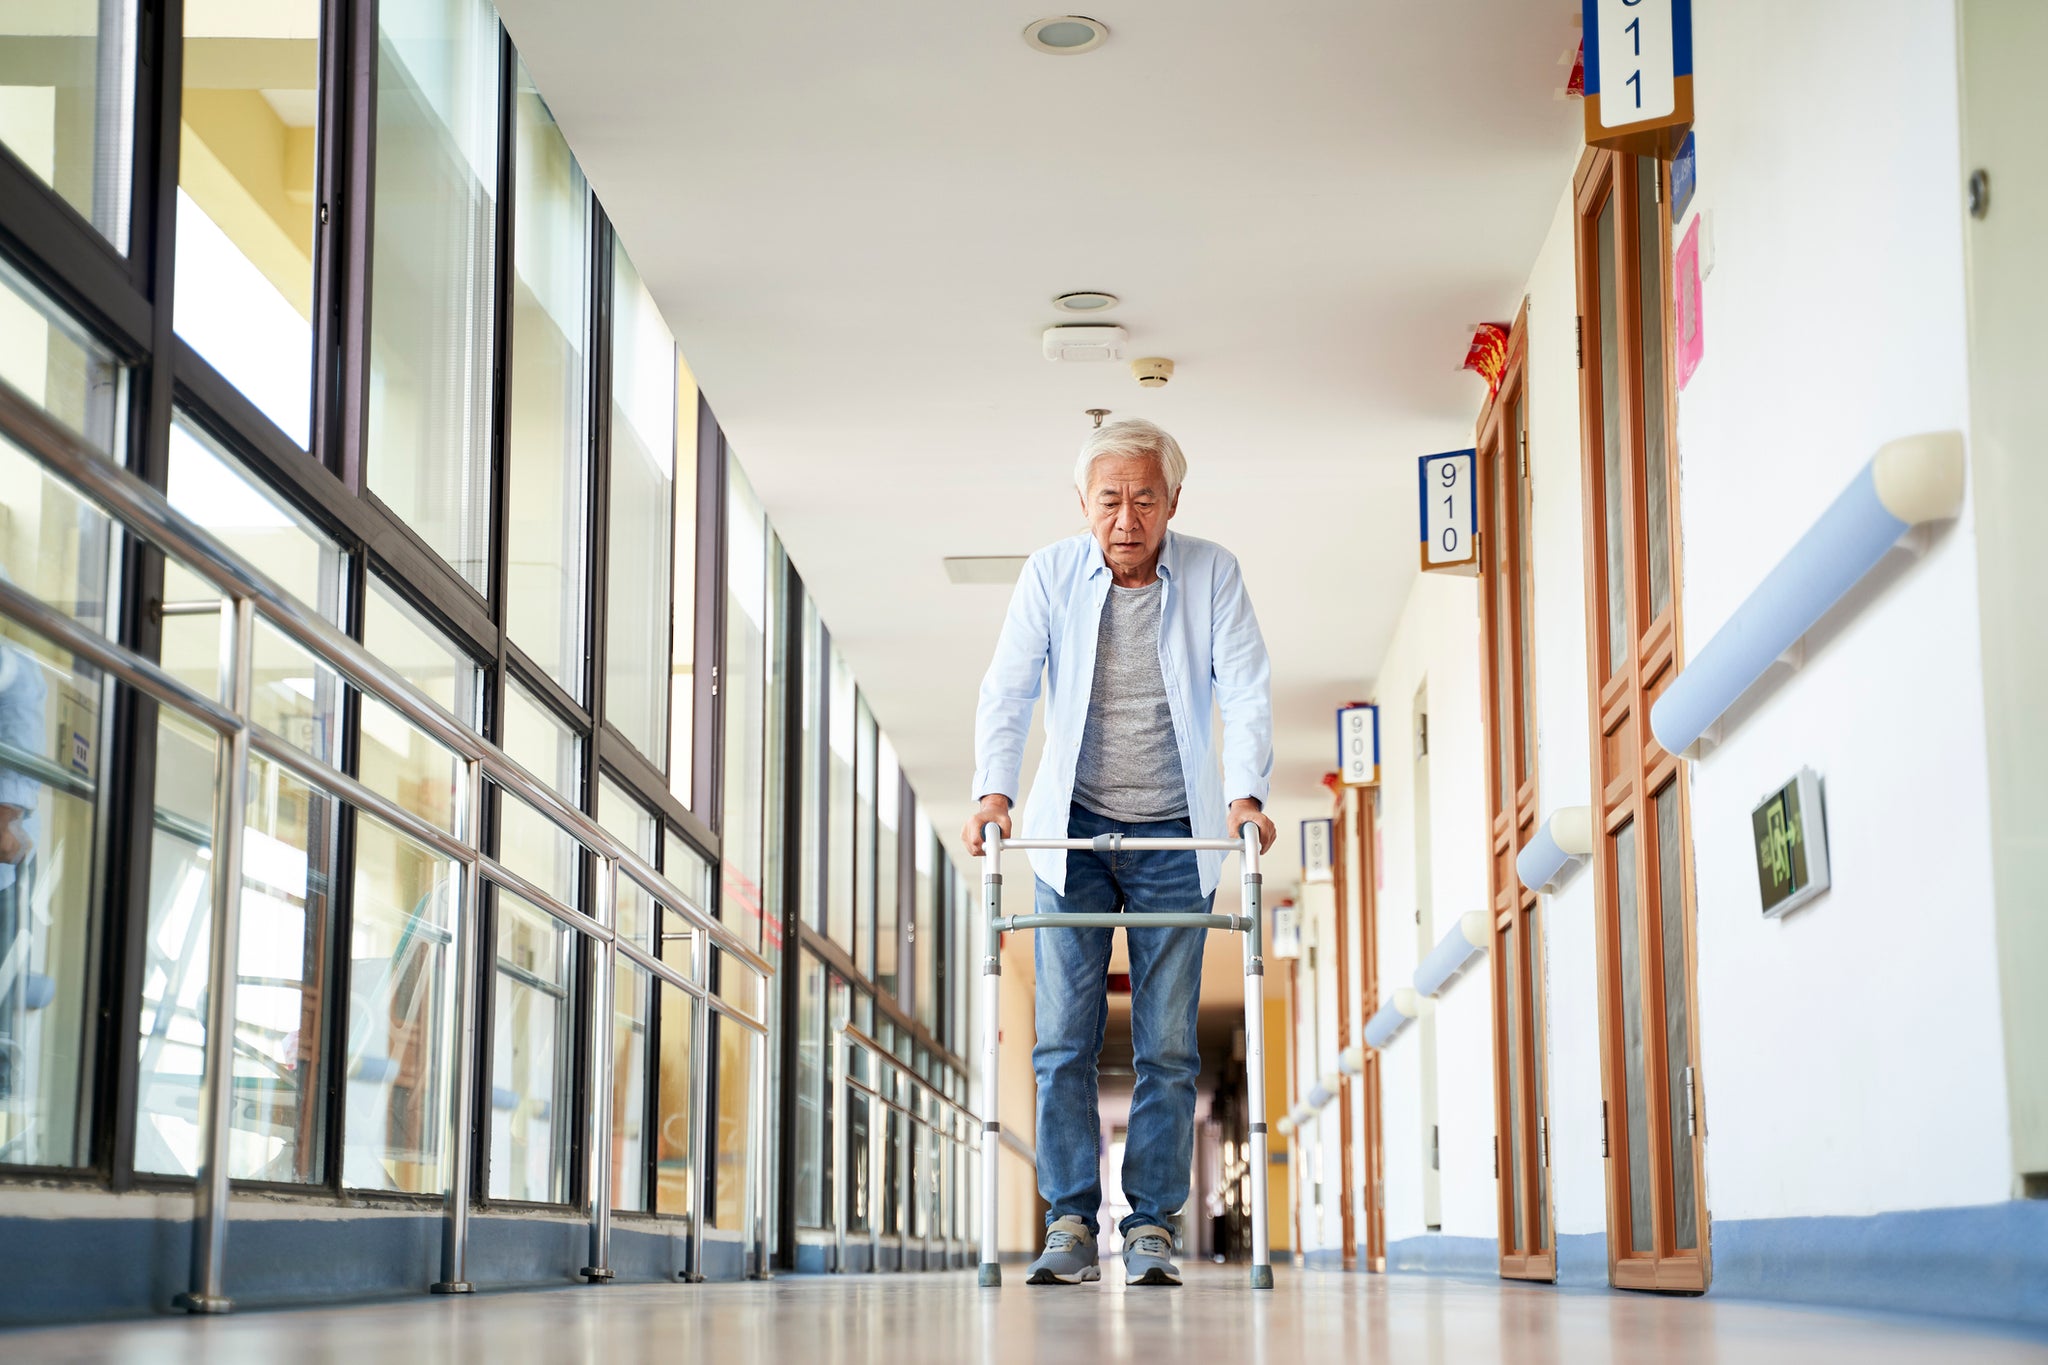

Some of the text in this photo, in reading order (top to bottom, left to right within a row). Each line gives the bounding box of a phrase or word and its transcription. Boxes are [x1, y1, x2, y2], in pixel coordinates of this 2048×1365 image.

[1621, 0, 1641, 109] 11
[1441, 463, 1457, 552] 910
[1352, 716, 1364, 778] 909
